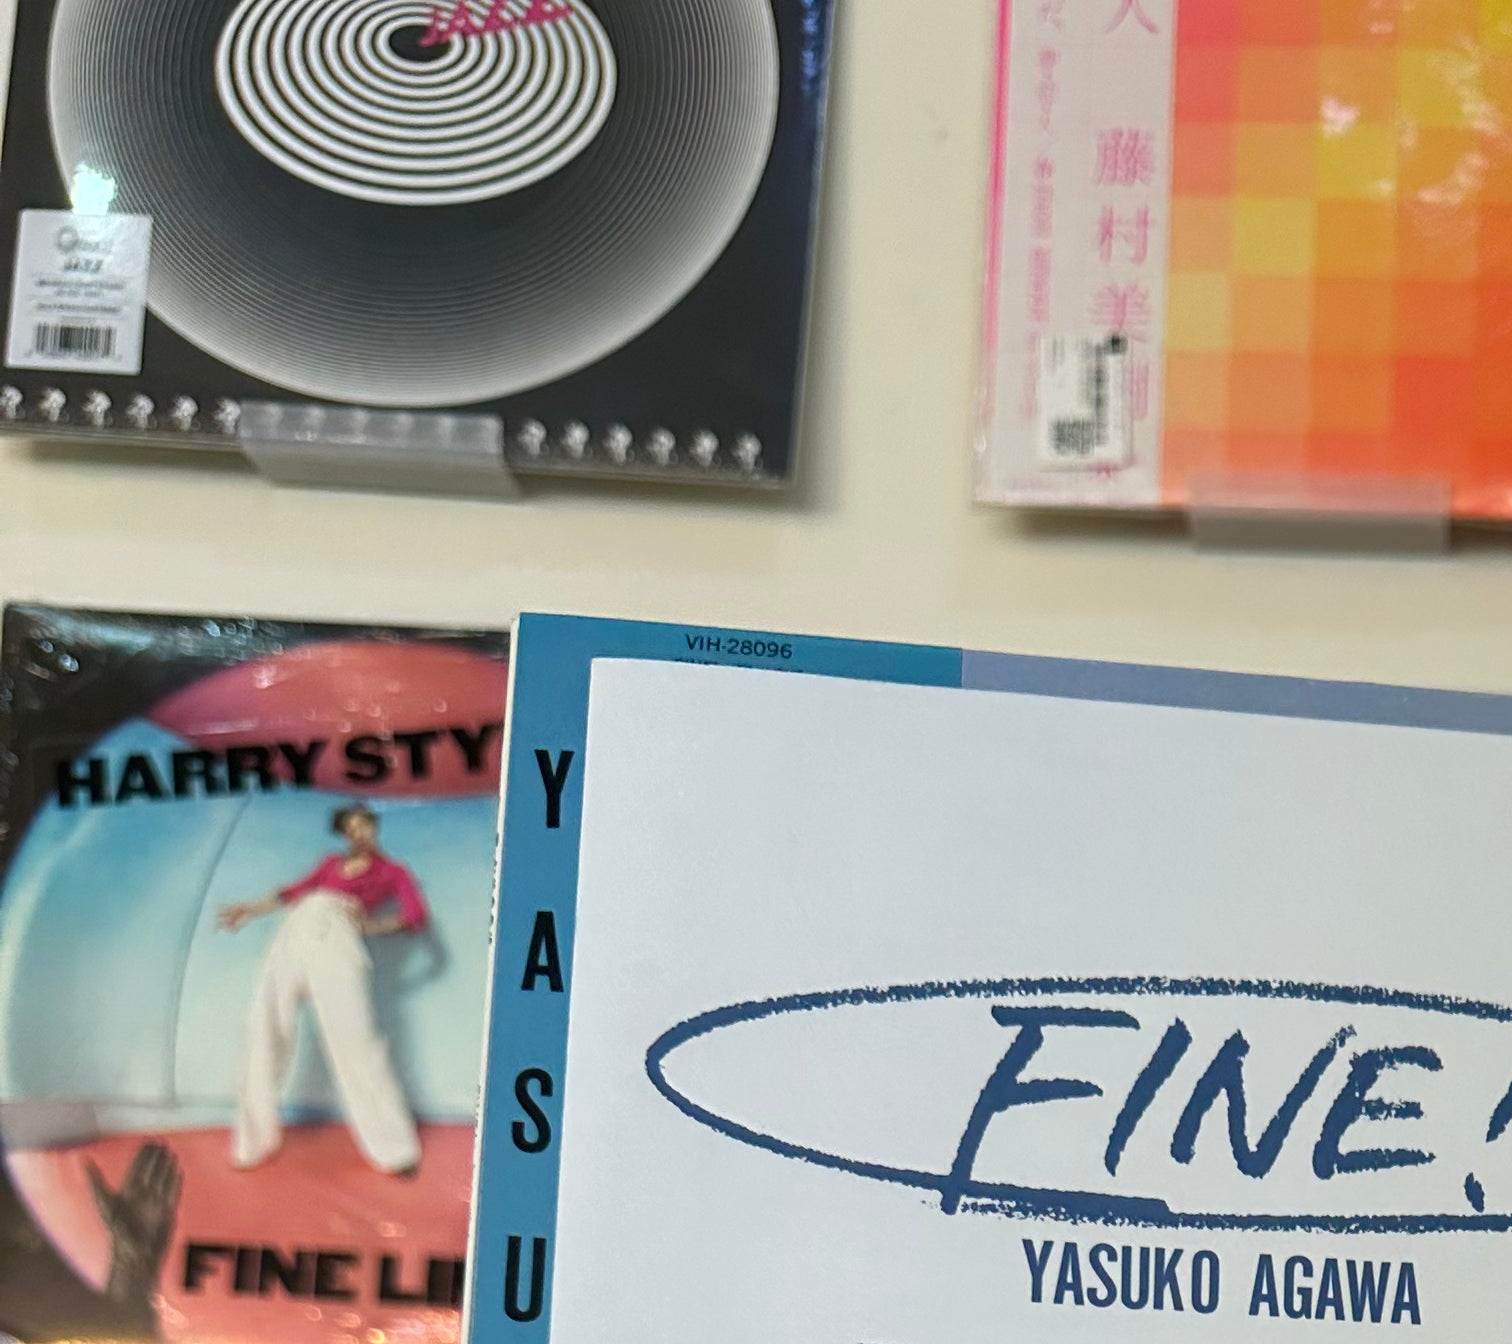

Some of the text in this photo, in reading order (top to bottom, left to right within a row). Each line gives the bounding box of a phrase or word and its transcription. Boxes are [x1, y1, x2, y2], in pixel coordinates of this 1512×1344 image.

[686, 634, 793, 660] VIH-28096
[54, 741, 326, 808] HARRY
[182, 1242, 362, 1300] FINE
[1021, 1238, 1421, 1325] YASUKO AGAWA
